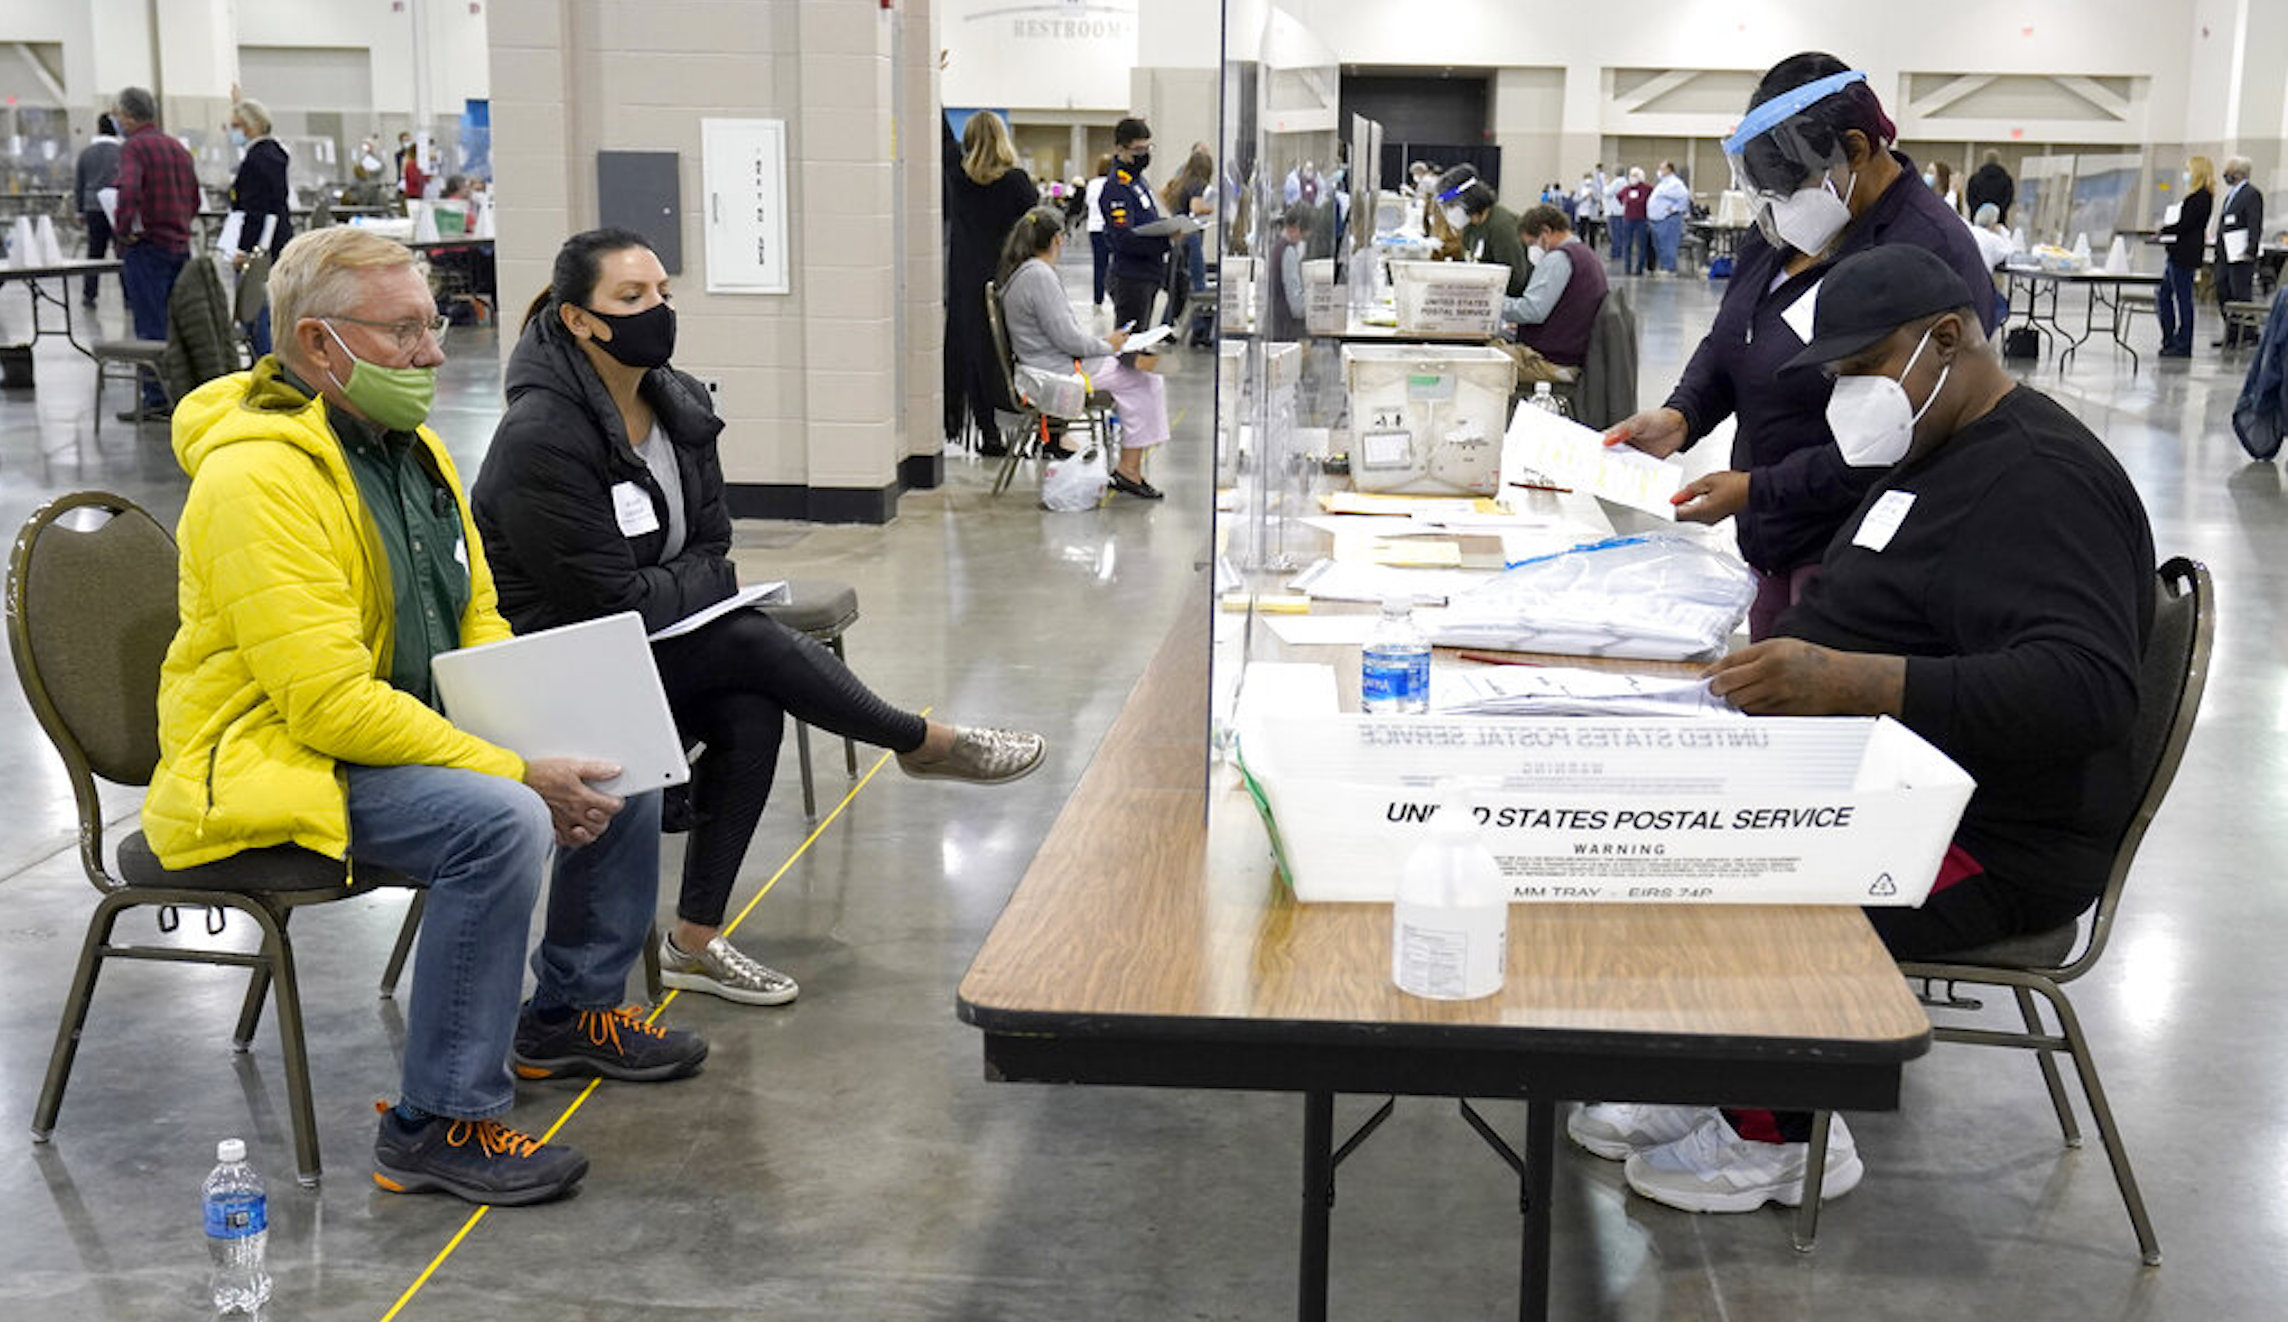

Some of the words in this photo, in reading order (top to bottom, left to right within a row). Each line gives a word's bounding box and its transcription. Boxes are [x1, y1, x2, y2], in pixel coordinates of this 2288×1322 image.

[1496, 807, 1609, 830] STATES
[1613, 810, 1724, 831] POSTAL
[1731, 806, 1855, 830] SERVICE
[1573, 843, 1666, 855] WARNING
[1513, 886, 1547, 898] MM
[1551, 886, 1602, 898] TRAY
